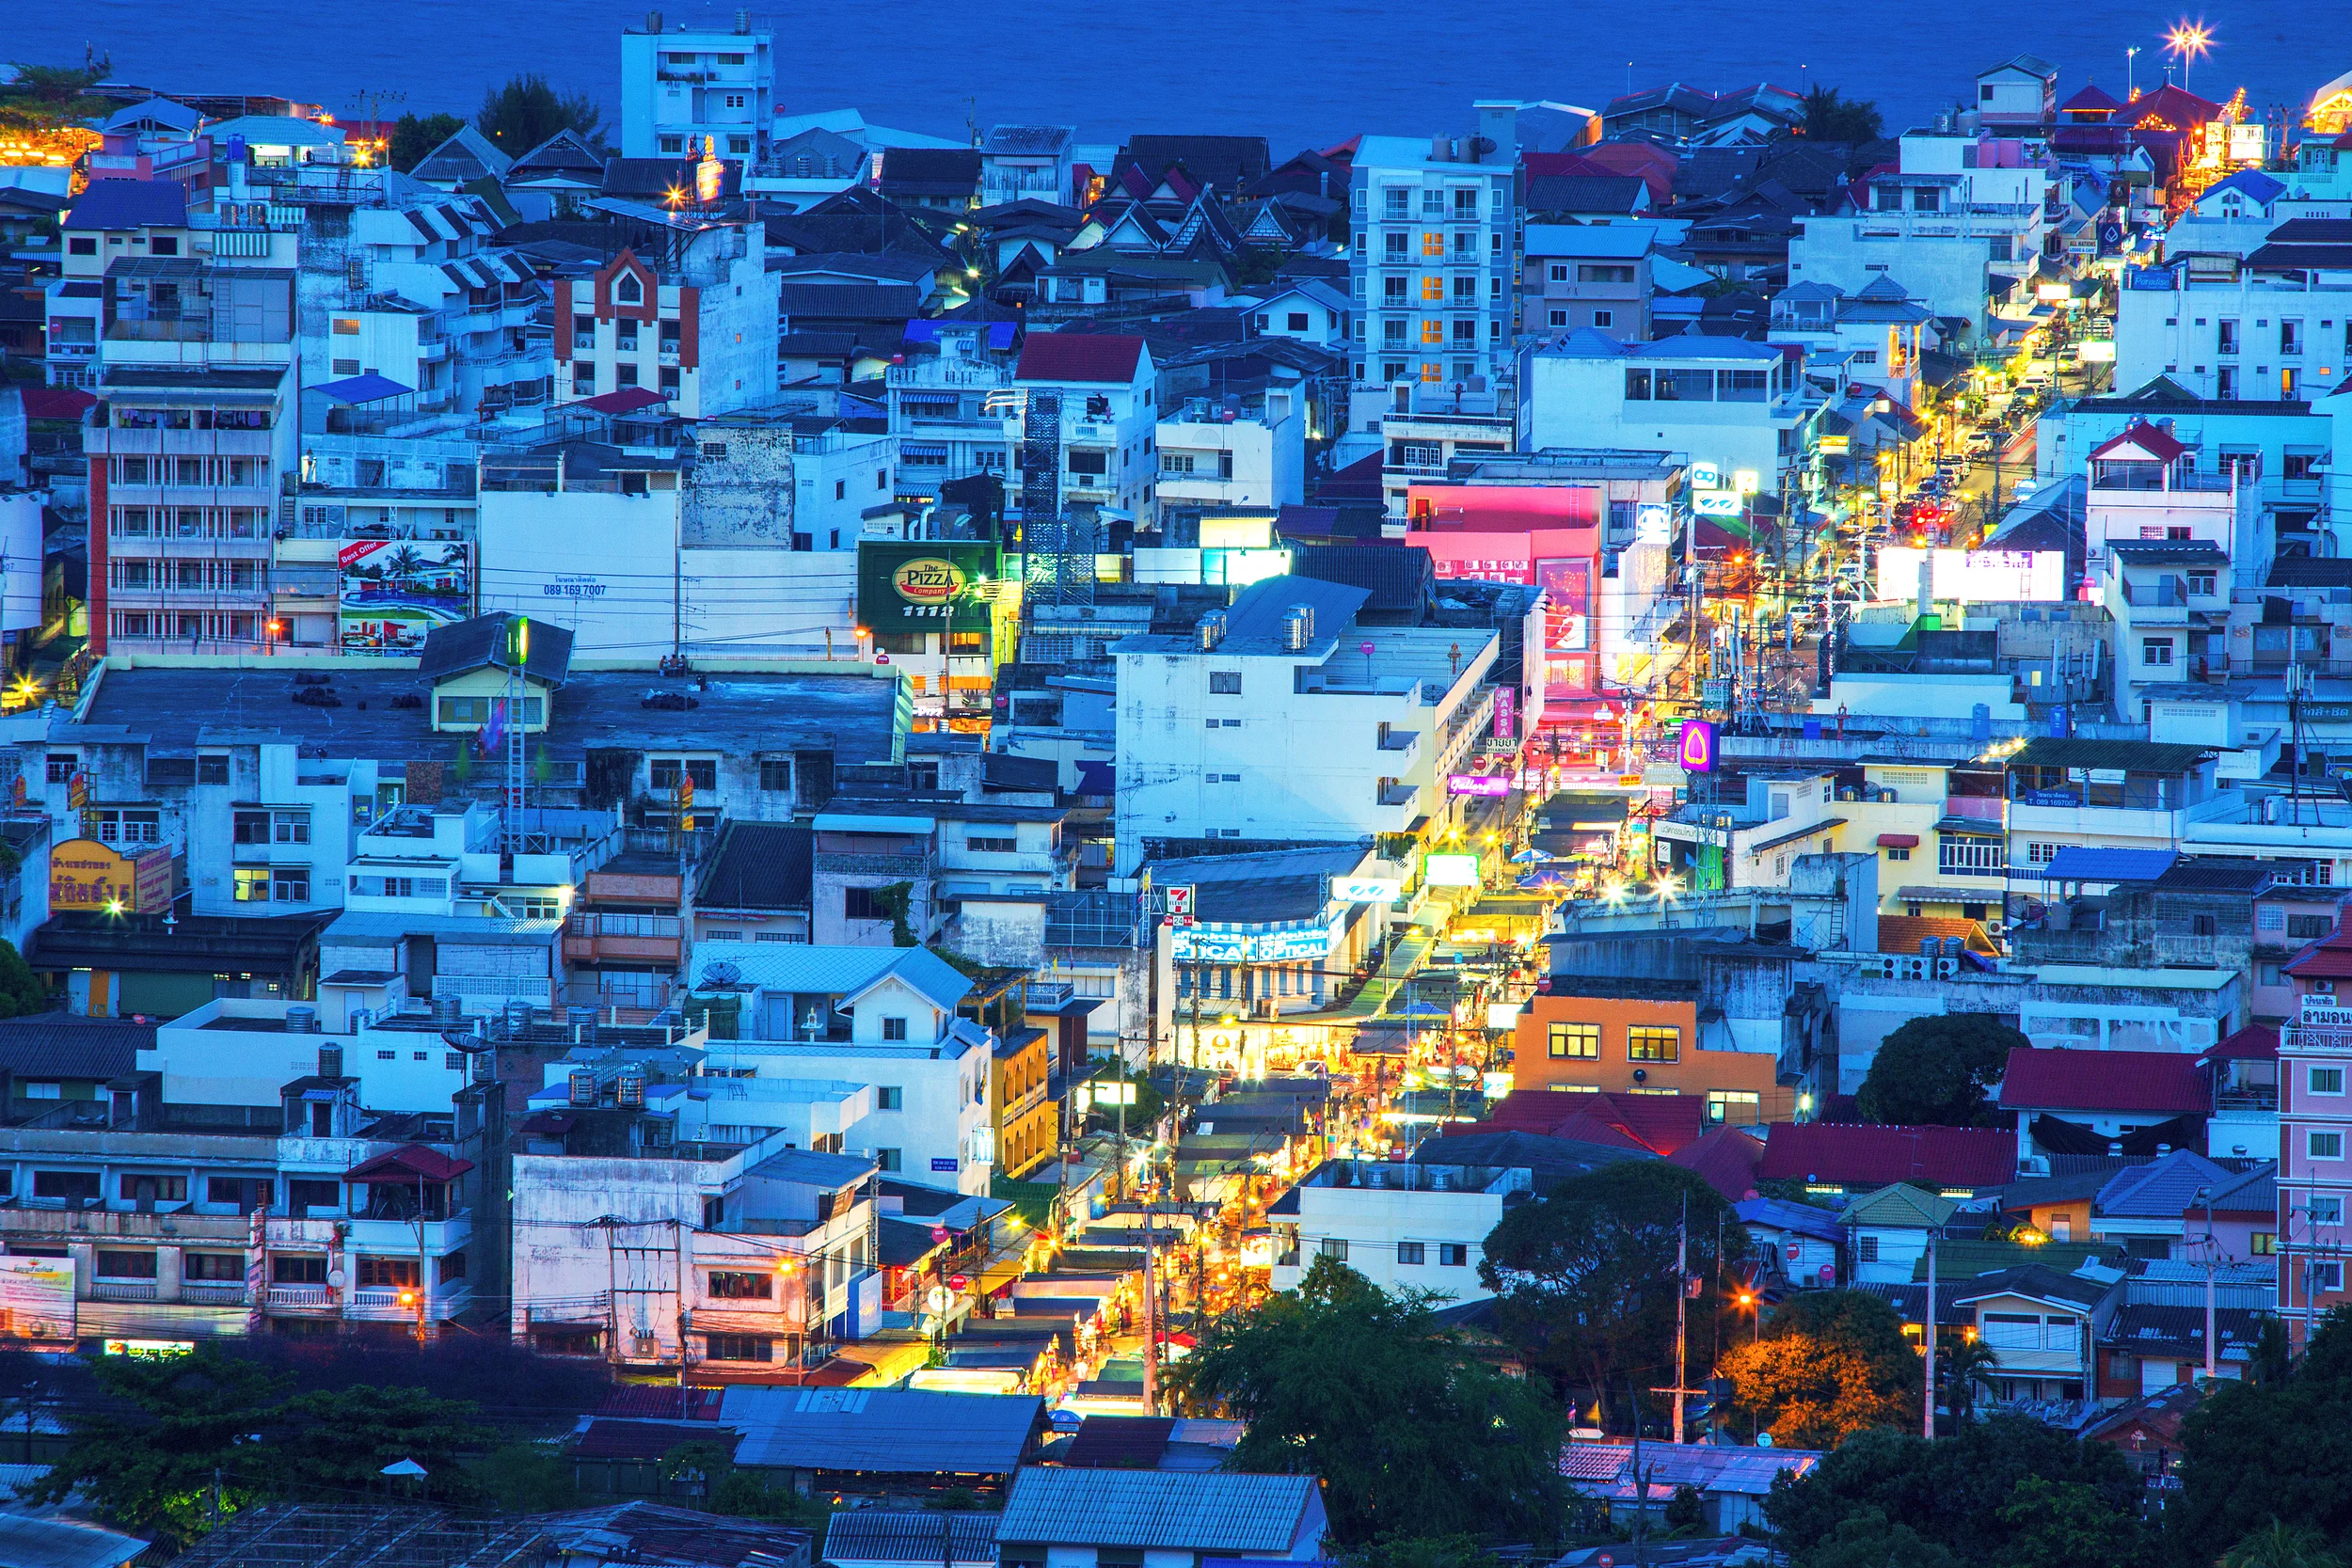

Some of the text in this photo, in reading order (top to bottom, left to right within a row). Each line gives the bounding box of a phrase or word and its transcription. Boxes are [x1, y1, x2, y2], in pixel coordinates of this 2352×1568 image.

[2134, 277, 2169, 286] Paradise
[341, 541, 378, 563] Best Offer
[924, 564, 938, 573] The
[907, 570, 955, 587] PIZZA
[544, 584, 606, 595] 089 169 7007
[914, 587, 946, 595] Company
[903, 606, 955, 617] 1112
[1486, 738, 1517, 747] ขายยา
[1451, 779, 1490, 794] Gallery
[1172, 945, 1257, 959] PTICAL
[1261, 942, 1328, 959] OPTICAL
[2303, 1008, 2352, 1024] สามอน
